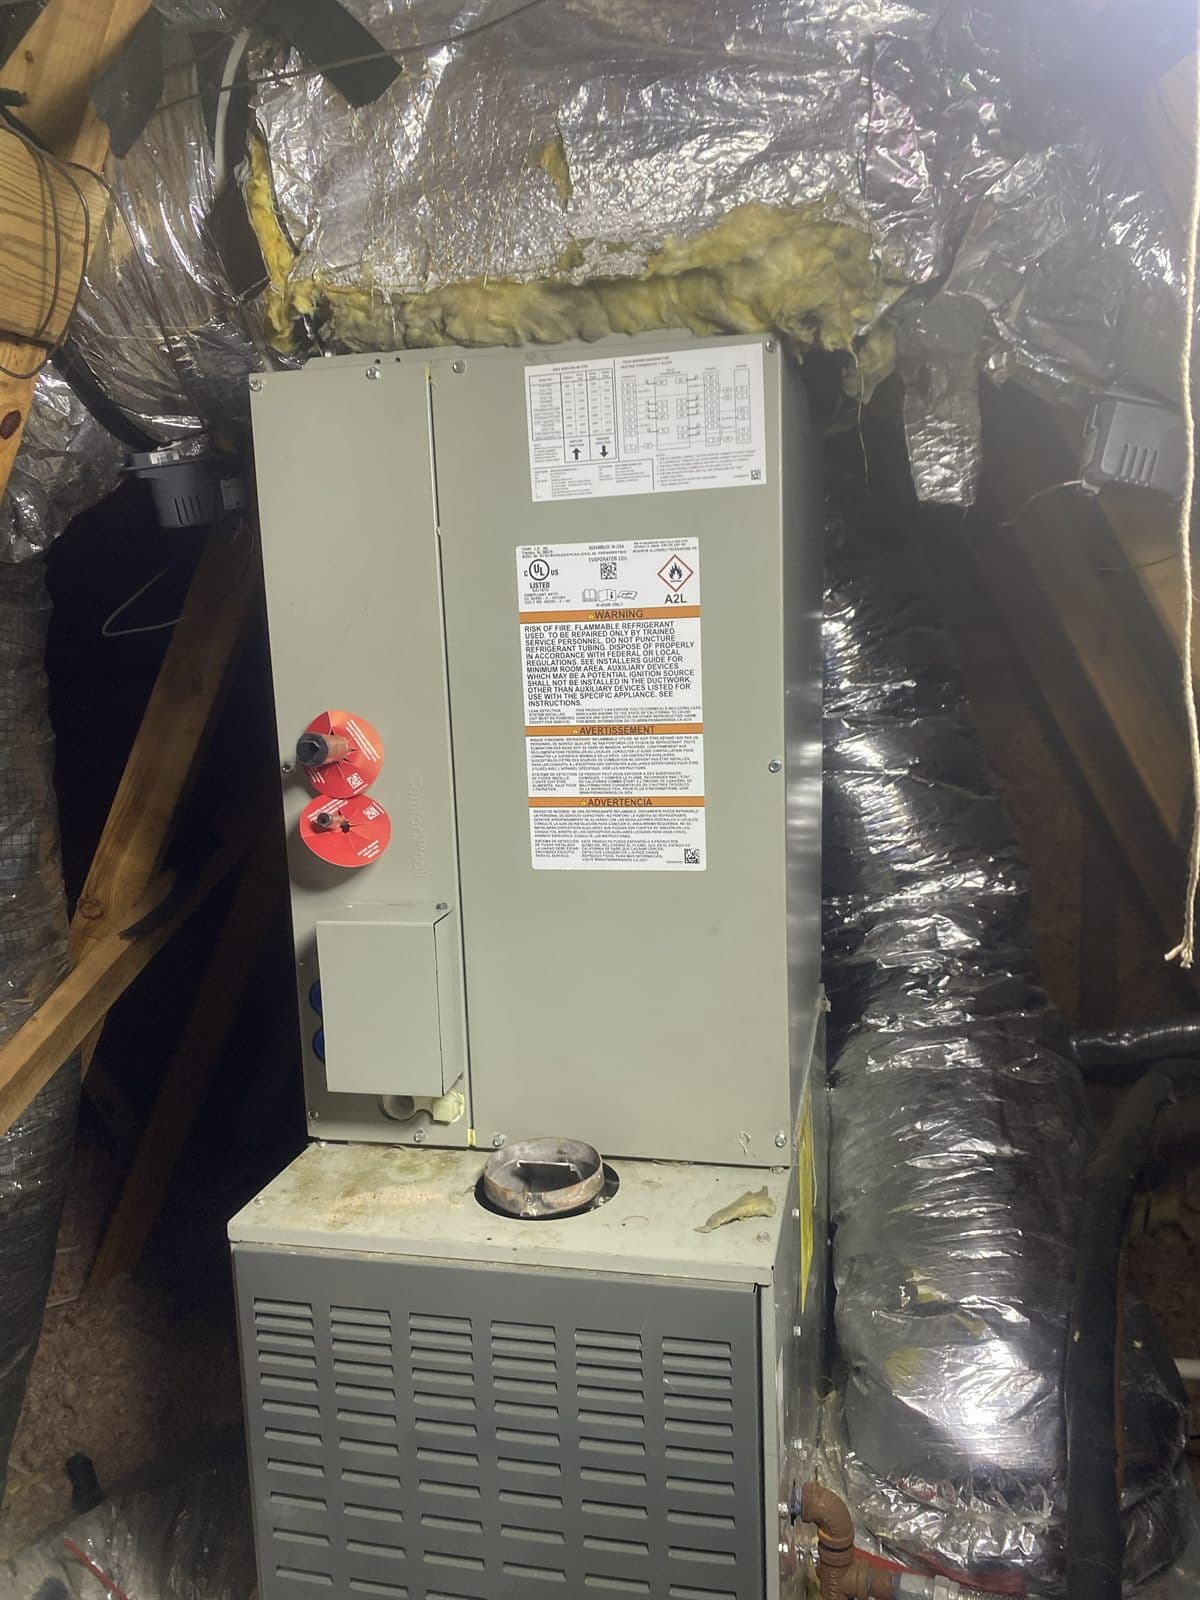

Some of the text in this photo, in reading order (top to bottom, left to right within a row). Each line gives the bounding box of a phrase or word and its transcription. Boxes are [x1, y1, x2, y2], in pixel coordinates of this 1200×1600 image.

[664, 594, 687, 604] A2L
[594, 609, 644, 619] WARNING
[621, 620, 673, 628] REFRIGERANT
[580, 726, 655, 735] AVERTISSEMENT
[588, 799, 652, 807] ADVERTENCIA
